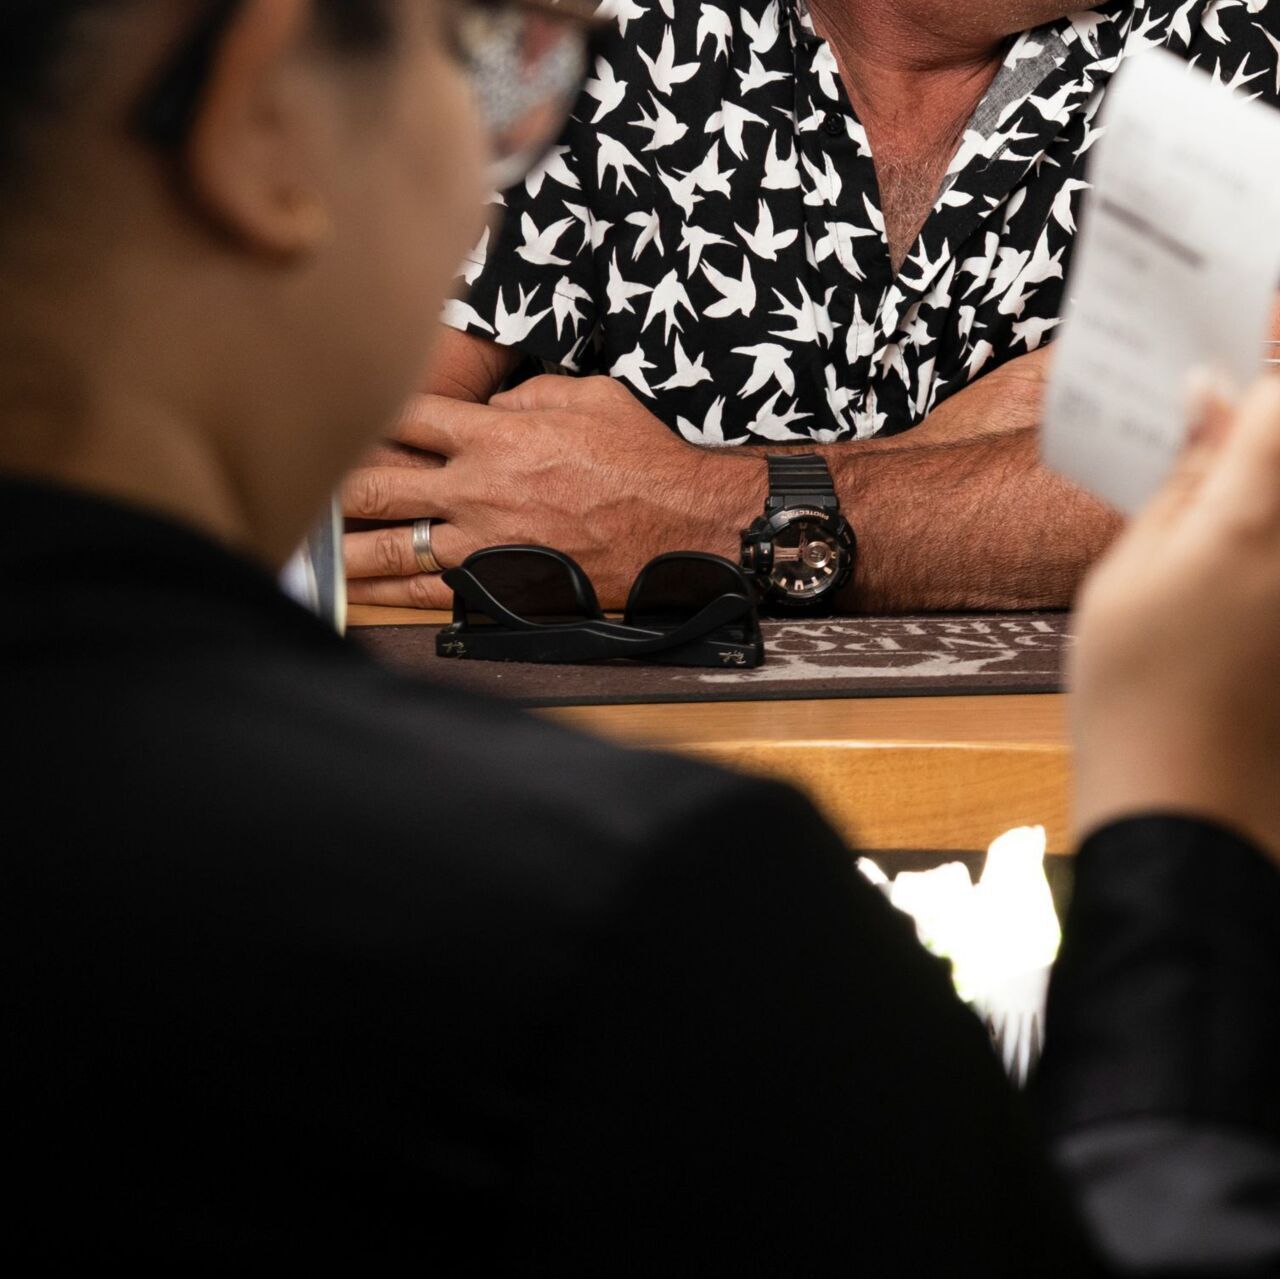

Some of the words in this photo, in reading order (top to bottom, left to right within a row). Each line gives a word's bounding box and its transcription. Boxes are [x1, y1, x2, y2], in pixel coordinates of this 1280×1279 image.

[774, 621, 1056, 638] BREW
[763, 637, 901, 653] PO
[937, 634, 1080, 650] ON
